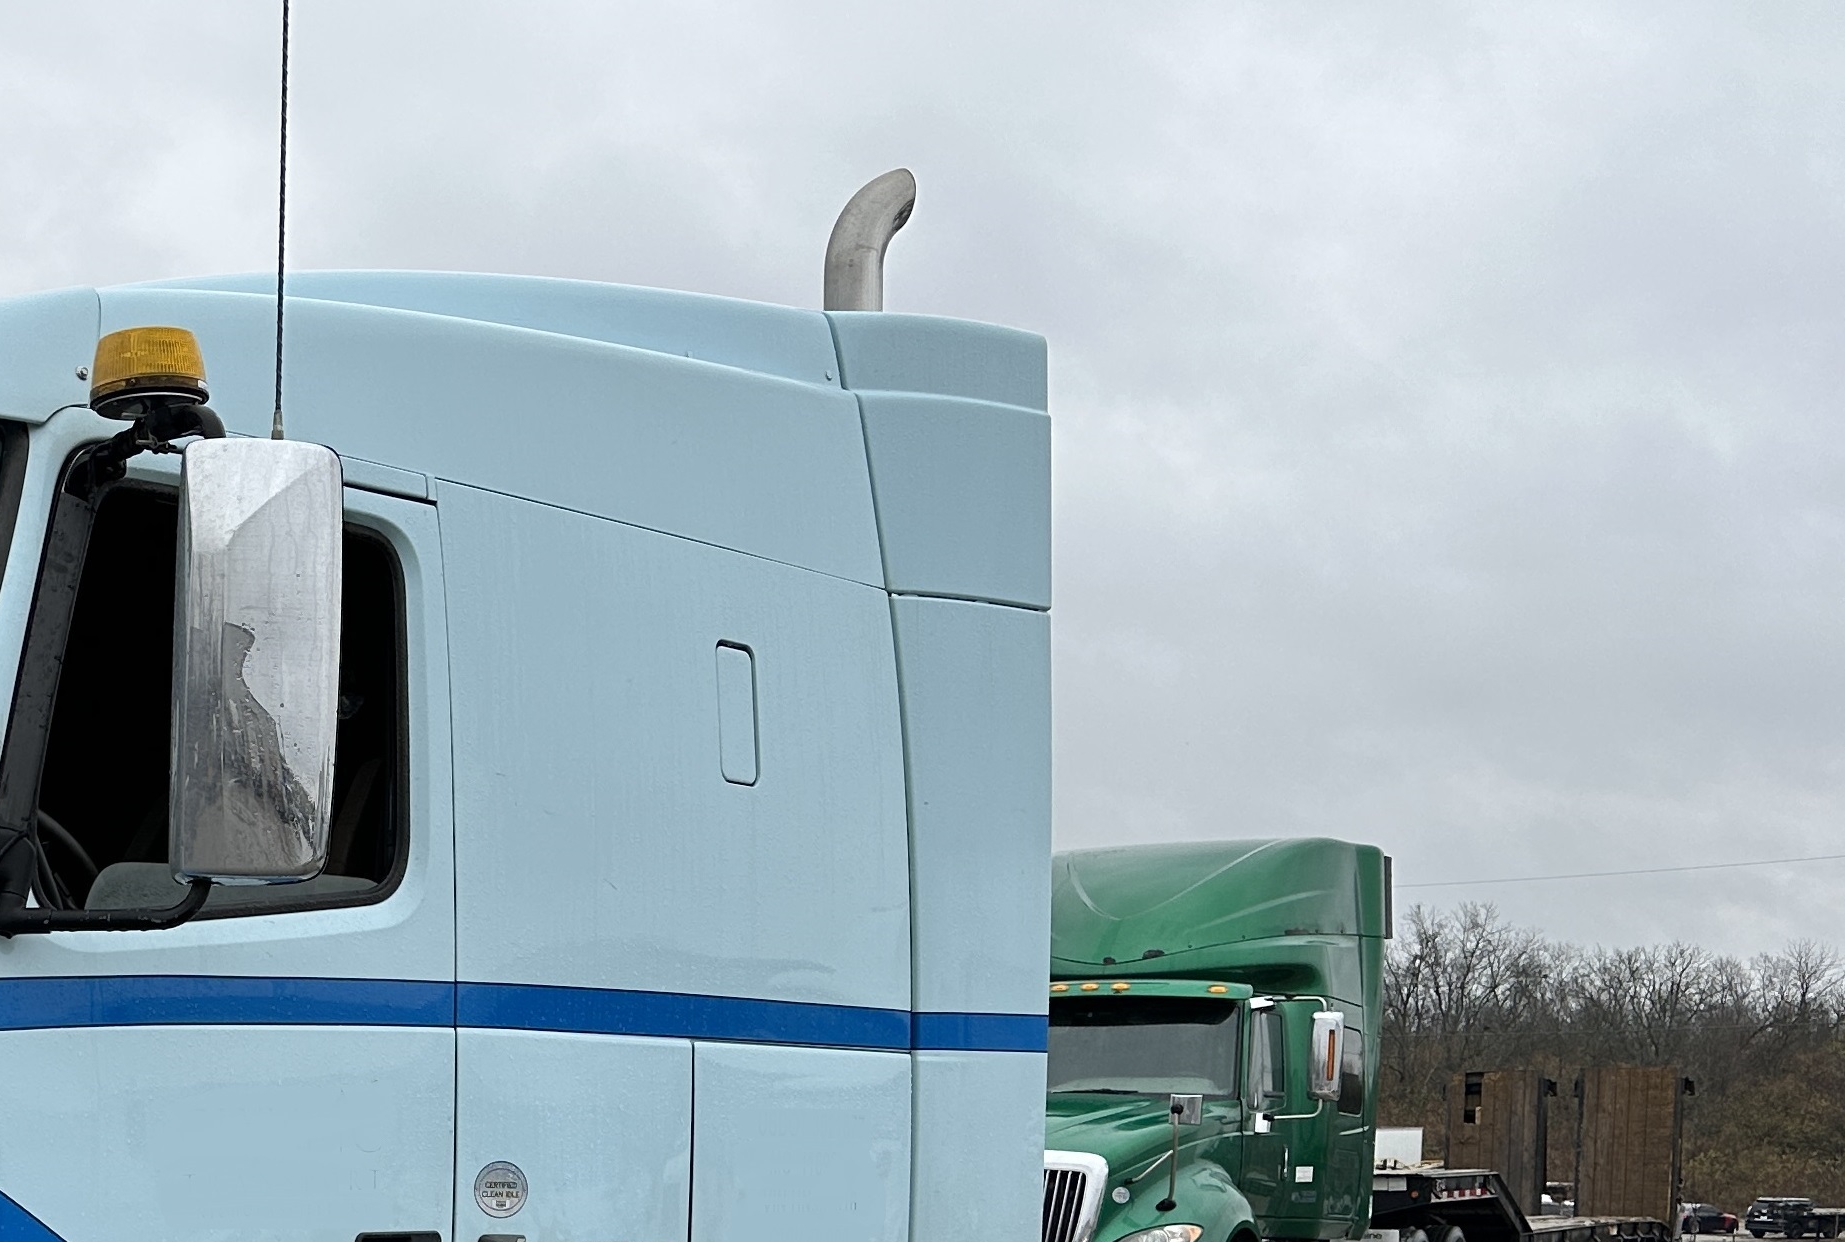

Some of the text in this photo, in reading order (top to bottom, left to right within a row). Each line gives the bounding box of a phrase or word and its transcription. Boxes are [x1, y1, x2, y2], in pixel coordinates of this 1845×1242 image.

[485, 1181, 518, 1189] CERTIFIED
[482, 1190, 520, 1199] CLEAN IDLE
